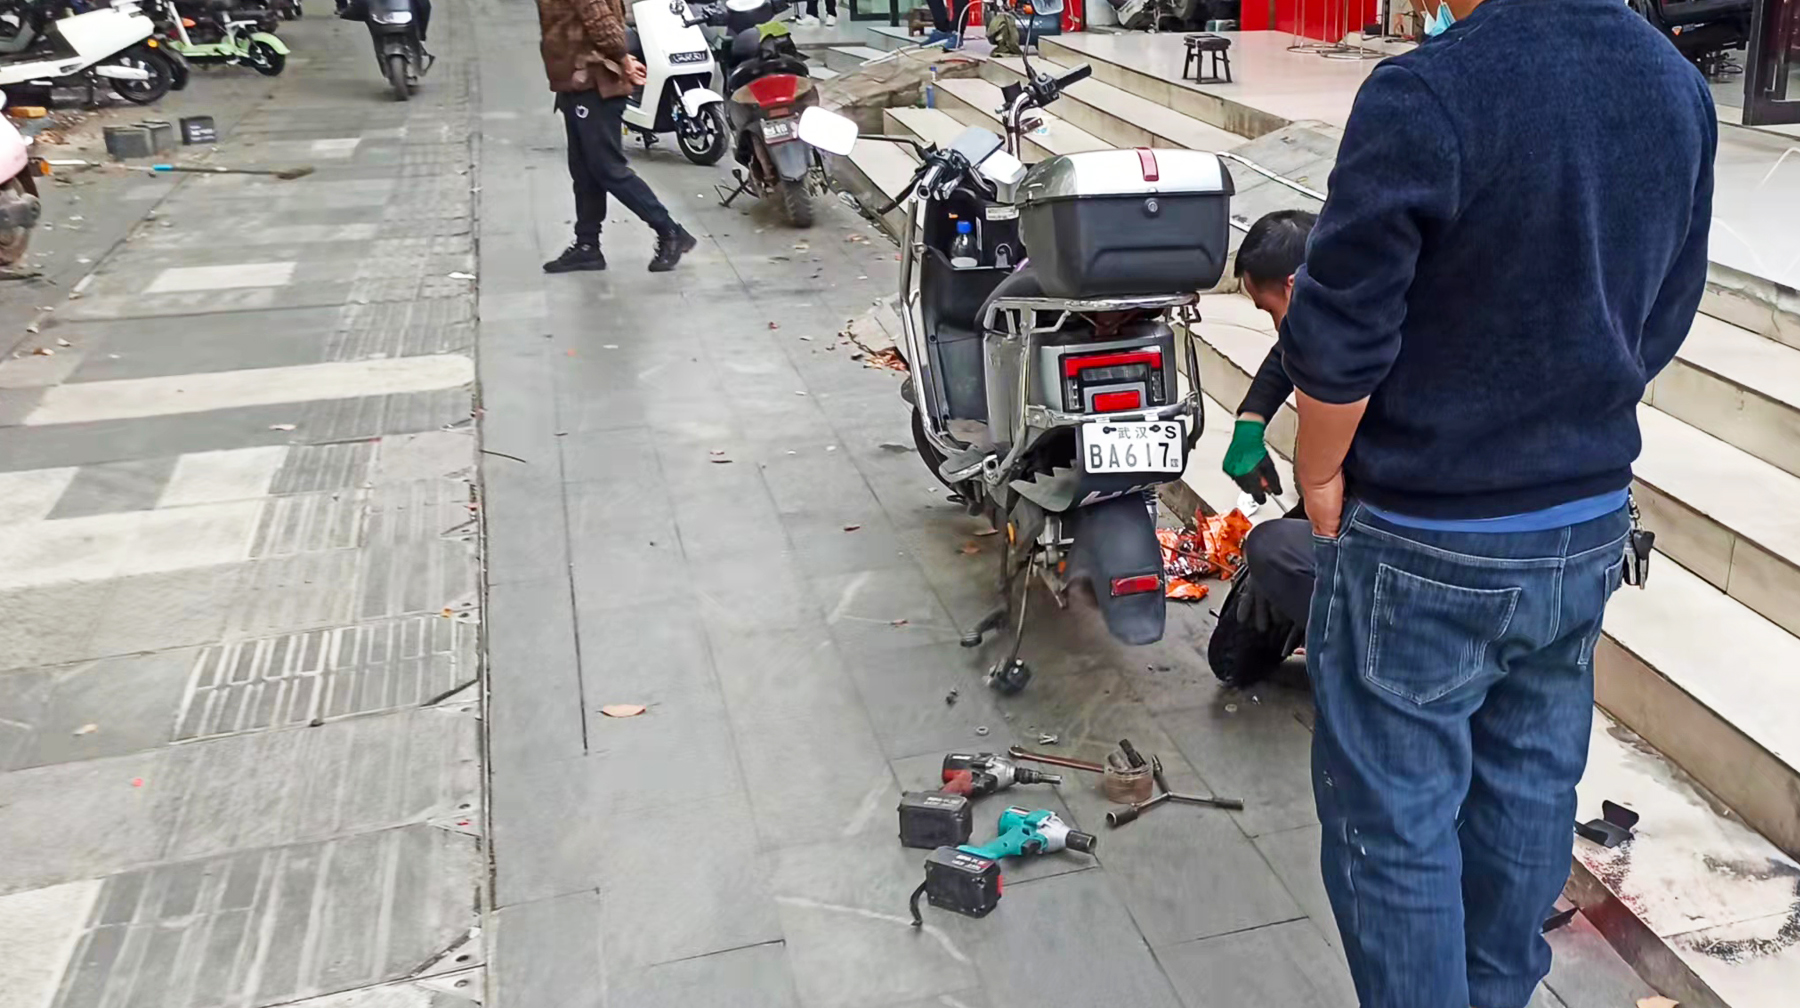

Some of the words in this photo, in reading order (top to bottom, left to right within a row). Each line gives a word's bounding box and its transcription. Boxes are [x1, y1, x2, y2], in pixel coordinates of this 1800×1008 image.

[1117, 426, 1149, 439] 武汉
[1164, 425, 1177, 439] S
[1089, 443, 1169, 468] BA617
